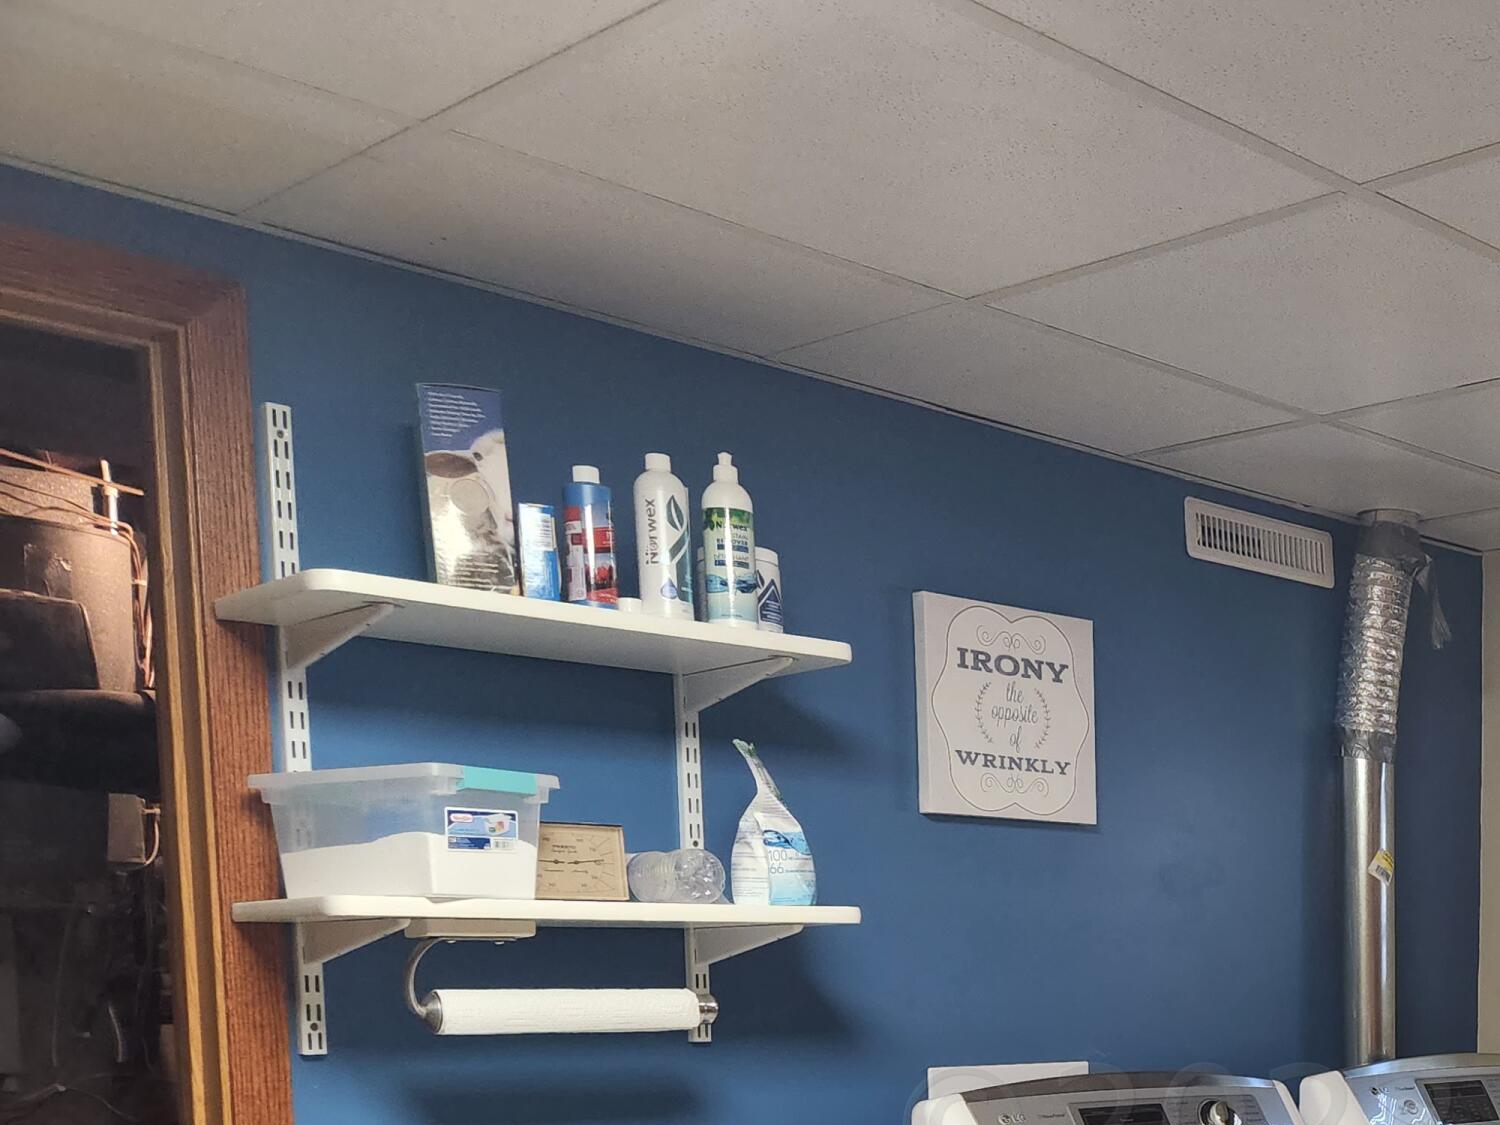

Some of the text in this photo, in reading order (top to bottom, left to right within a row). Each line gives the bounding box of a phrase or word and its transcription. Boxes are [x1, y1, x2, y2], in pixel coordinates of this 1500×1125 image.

[956, 647, 1069, 684] IRONY
[1006, 680, 1024, 704] the
[991, 702, 1039, 729] opposite
[1009, 726, 1023, 753] of
[955, 749, 1071, 776] WRINKLY
[768, 849, 787, 862] 100
